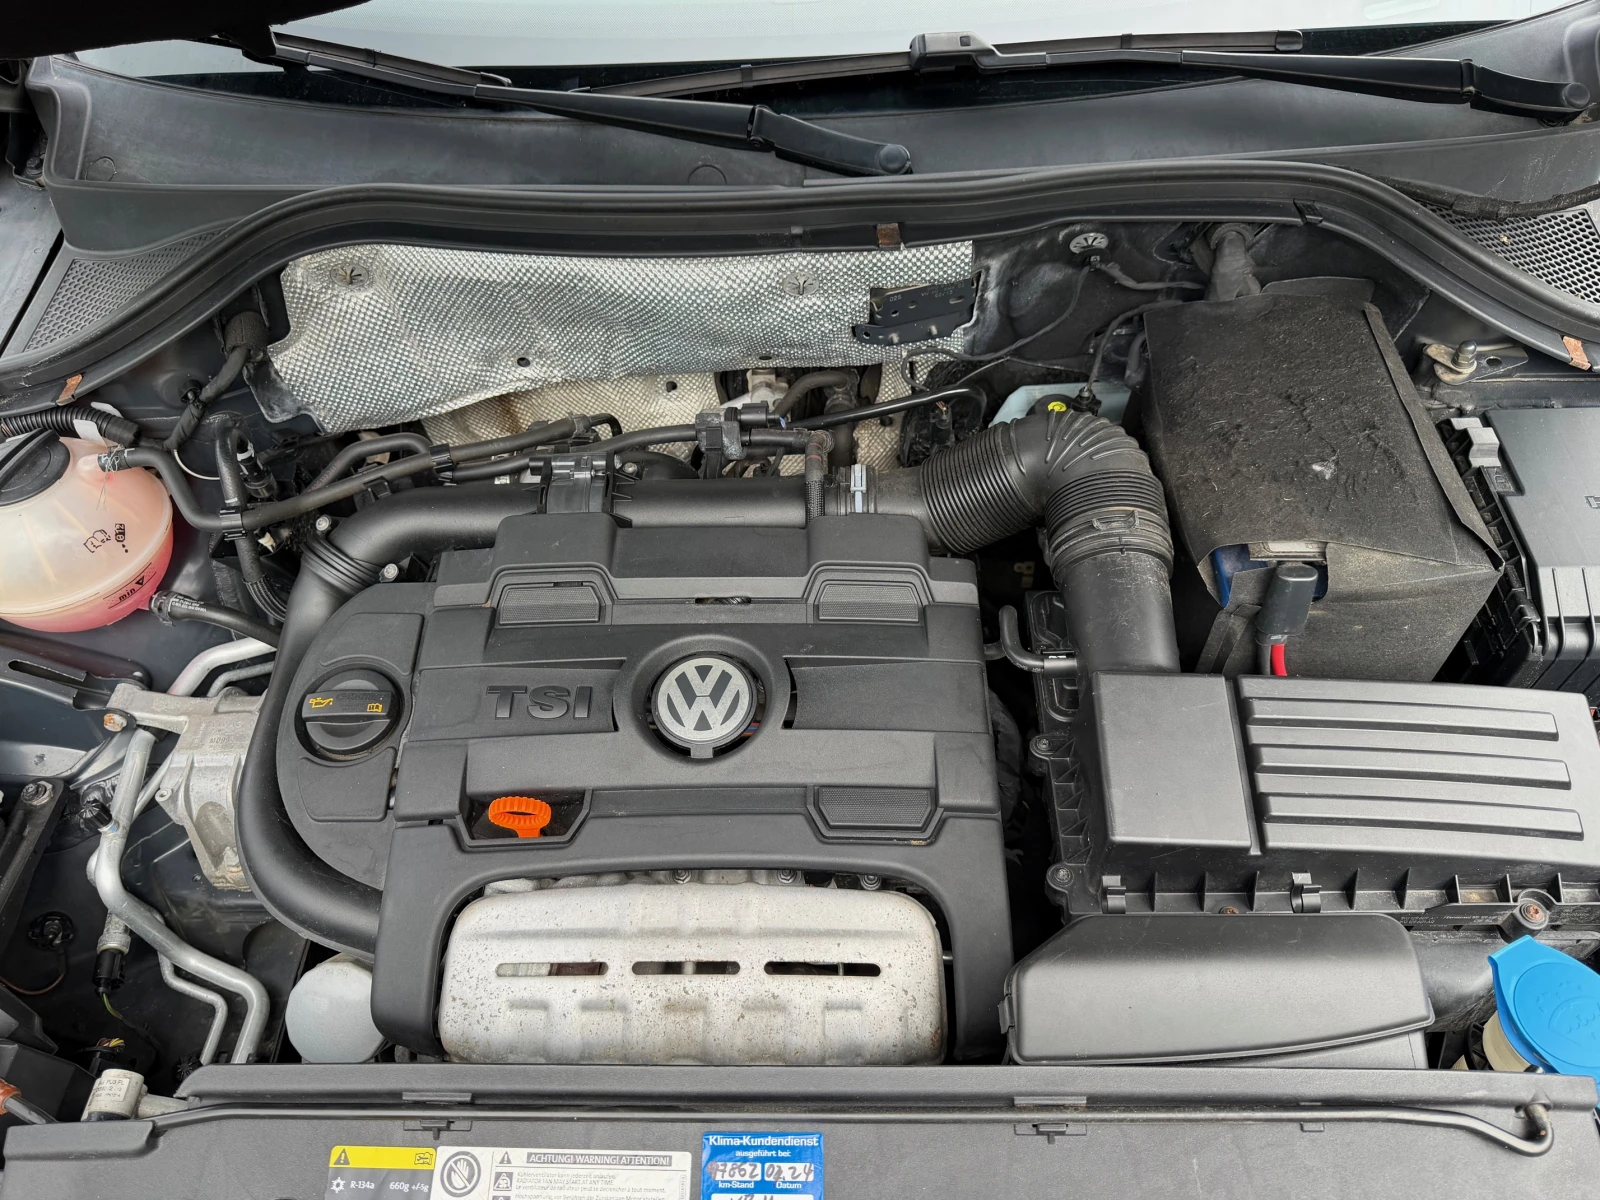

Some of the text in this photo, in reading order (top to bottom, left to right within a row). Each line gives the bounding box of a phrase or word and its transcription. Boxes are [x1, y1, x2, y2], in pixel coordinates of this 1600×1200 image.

[118, 586, 136, 601] min
[487, 685, 593, 720] TSI
[708, 1135, 819, 1147] Klima-Kundendienst
[528, 1153, 670, 1166] ACHTUNG! WARNING! ATTENTION!
[735, 1149, 777, 1159] ausgeführt
[350, 1181, 375, 1190] R-134a
[389, 1181, 410, 1193] 660g
[718, 1180, 755, 1189] km-Stand
[775, 1180, 802, 1189] Datum
